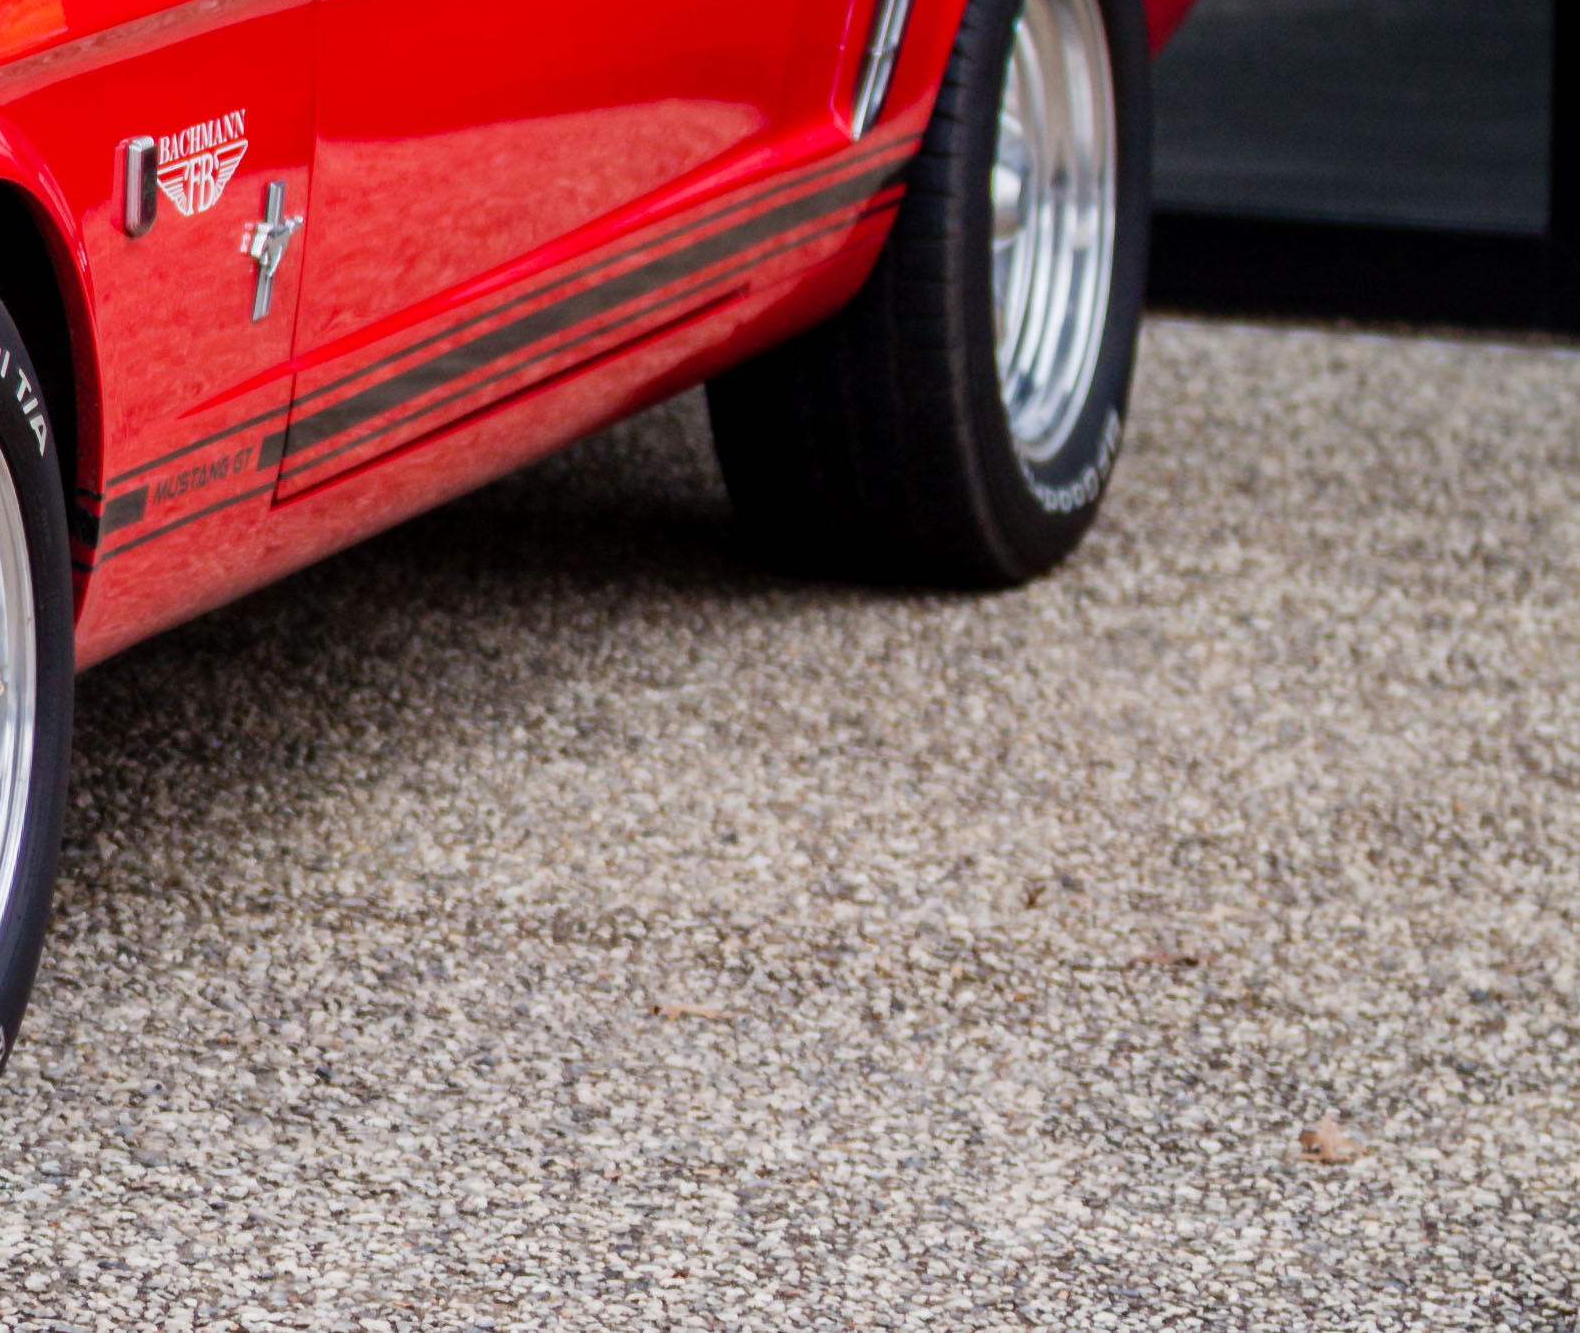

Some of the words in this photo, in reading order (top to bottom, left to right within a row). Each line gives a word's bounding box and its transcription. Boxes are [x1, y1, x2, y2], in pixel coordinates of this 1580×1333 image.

[159, 108, 246, 165] BACHMANN
[153, 455, 230, 505] MUSTANG
[232, 446, 255, 475] GT
